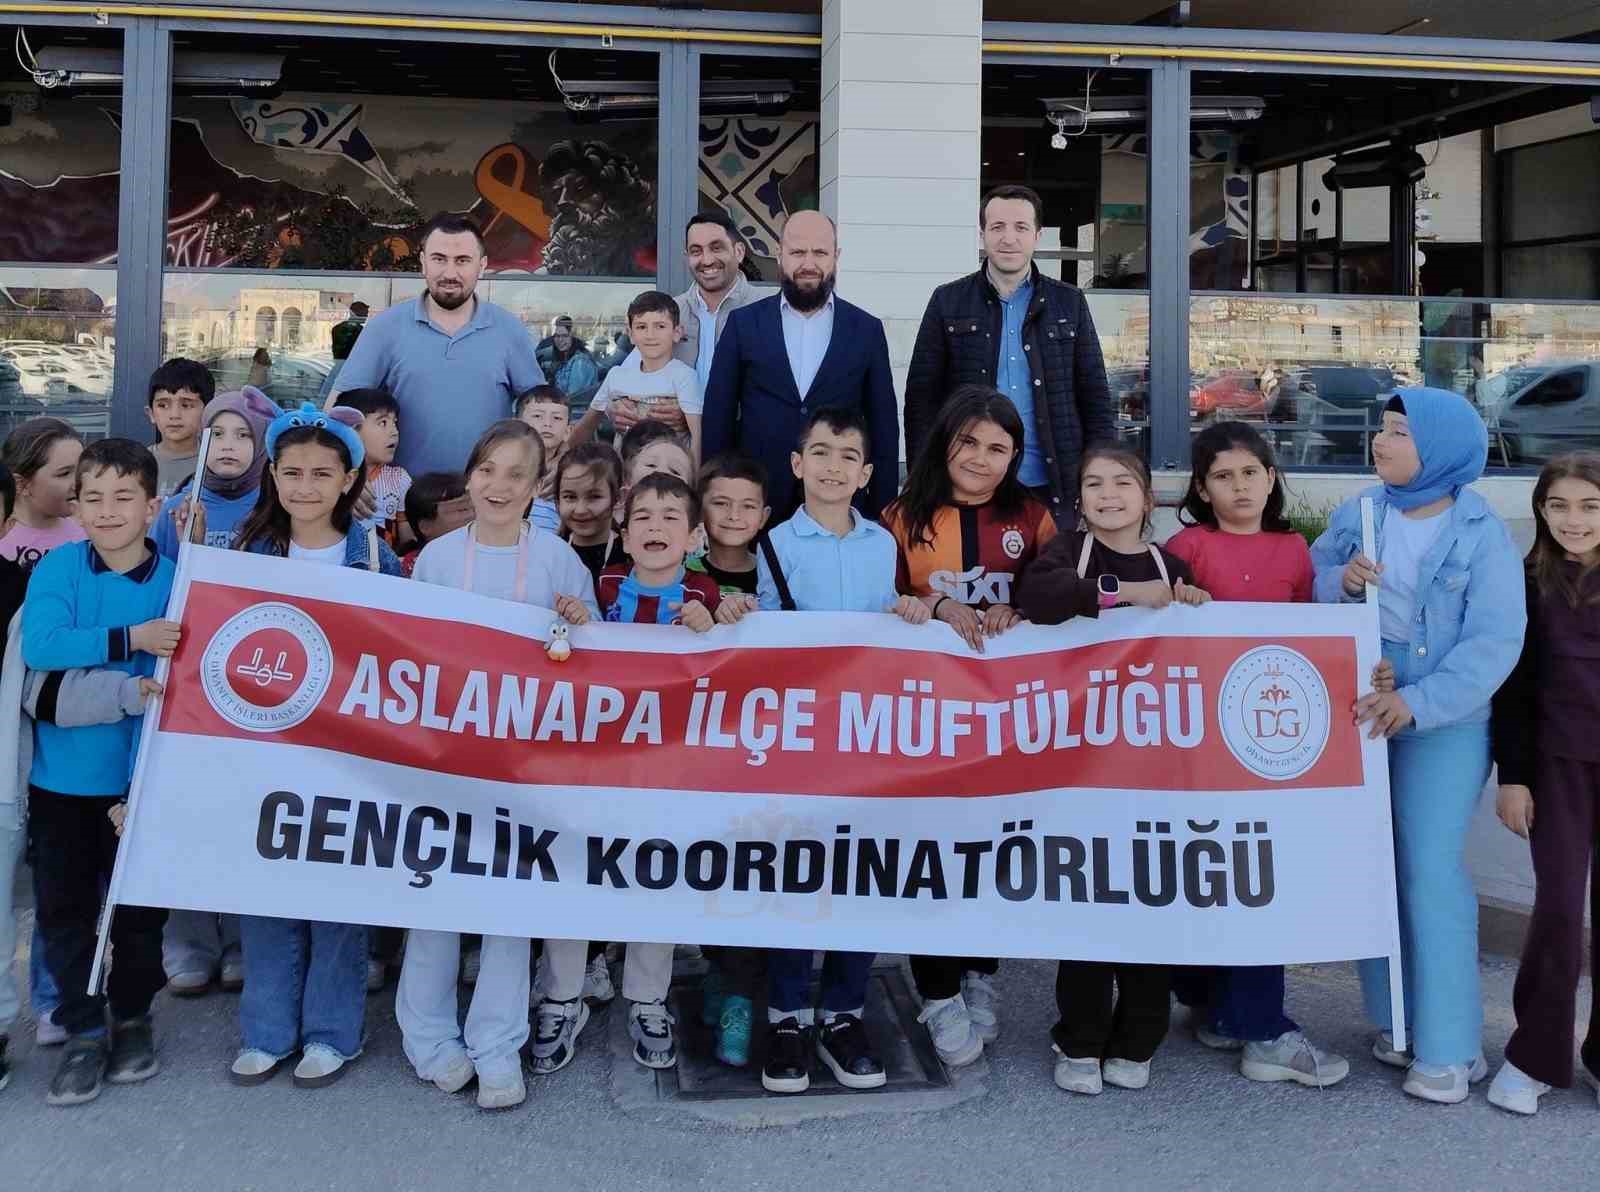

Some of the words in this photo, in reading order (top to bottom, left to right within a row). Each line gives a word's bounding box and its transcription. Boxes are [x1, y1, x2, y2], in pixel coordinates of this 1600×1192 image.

[337, 653, 663, 746] ASLANAPA
[684, 677, 817, 769] İLÇE
[838, 662, 1206, 757] MÜFTÜLÜĞÜ
[1252, 708, 1301, 738] DG
[256, 790, 560, 889] GENÇLİK
[586, 819, 1275, 908] KOORDİNATÖRLÜĞÜ
